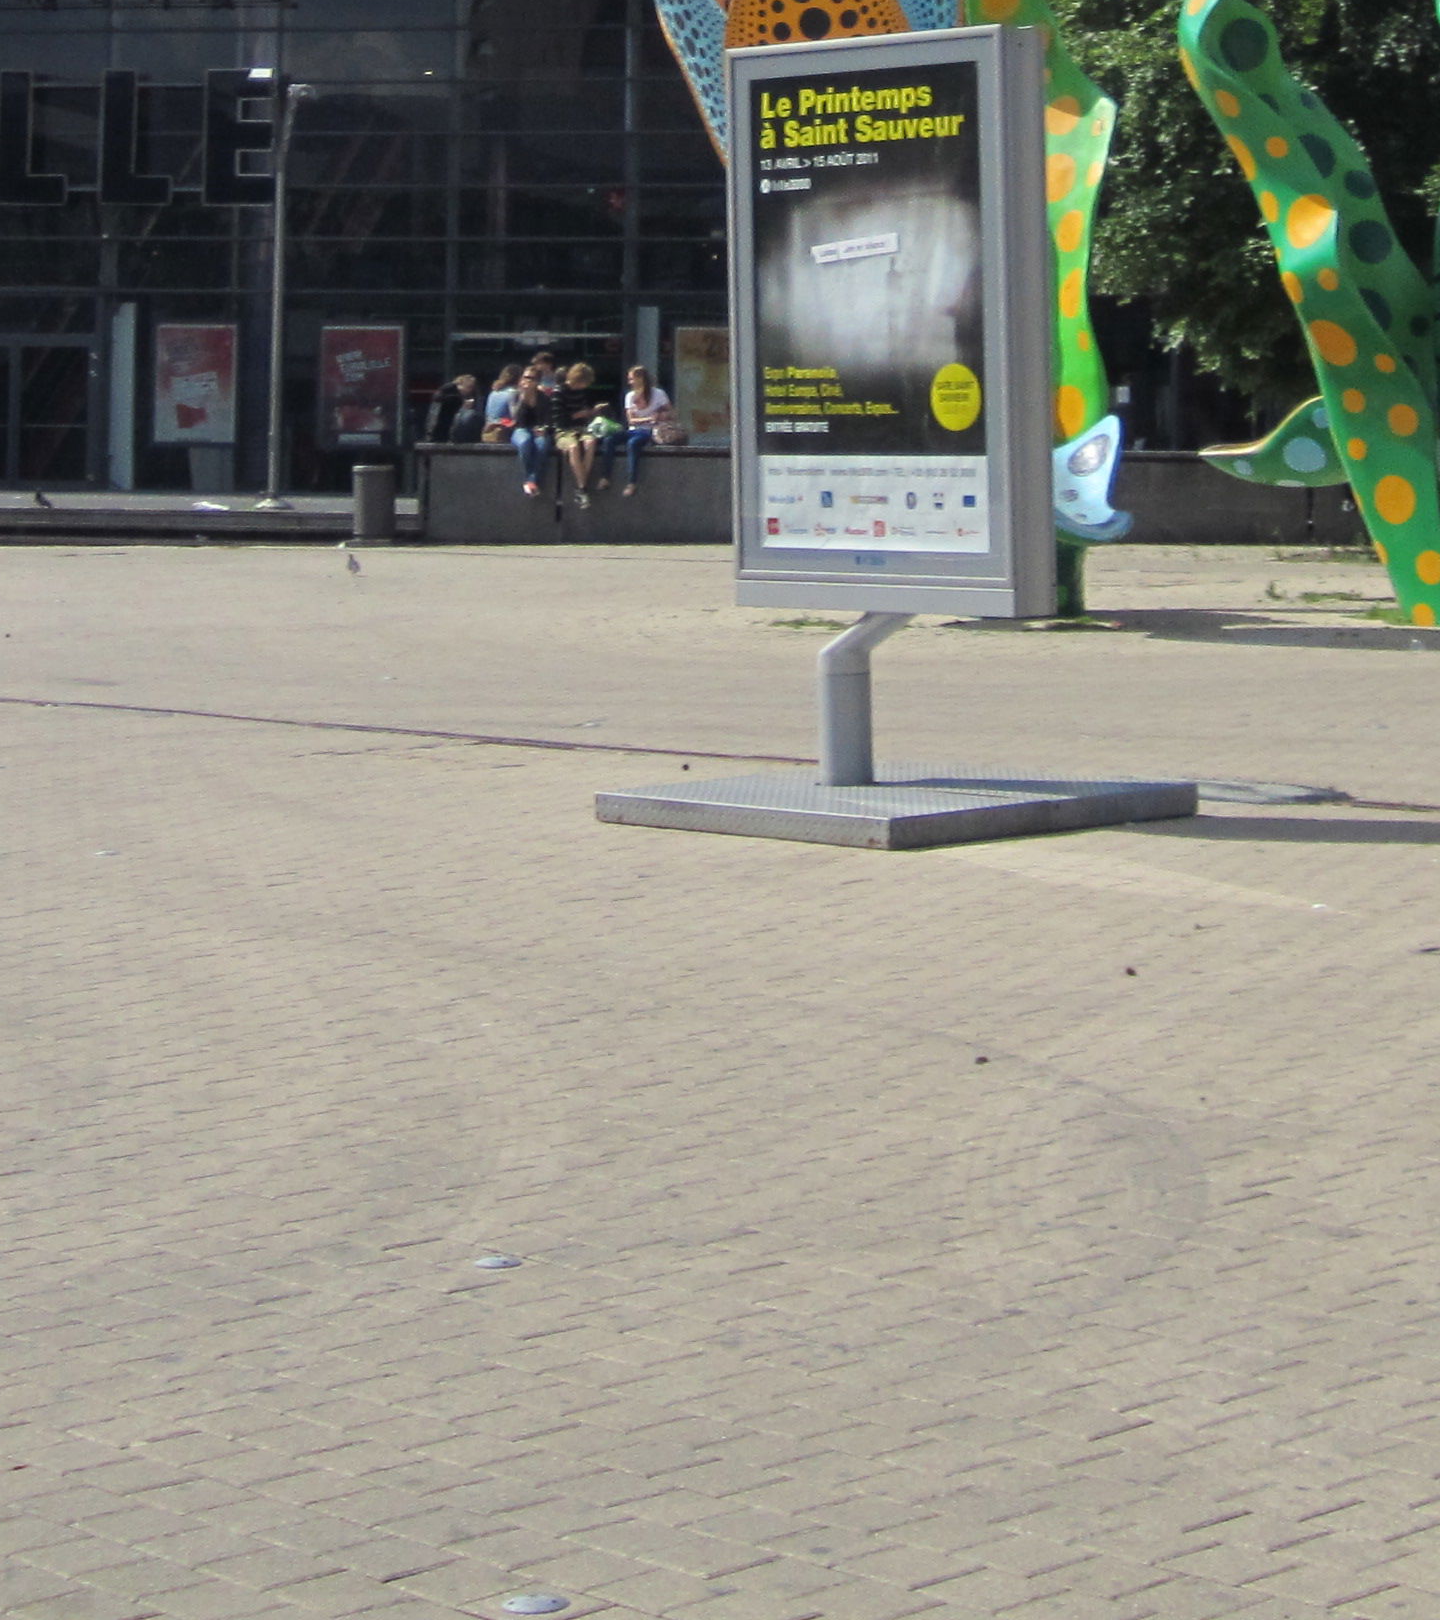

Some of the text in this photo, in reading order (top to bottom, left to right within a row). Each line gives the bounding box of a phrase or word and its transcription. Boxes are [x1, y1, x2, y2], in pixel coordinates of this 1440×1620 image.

[760, 85, 933, 119] Le Printemps
[760, 114, 965, 149] à Saint Sauveur
